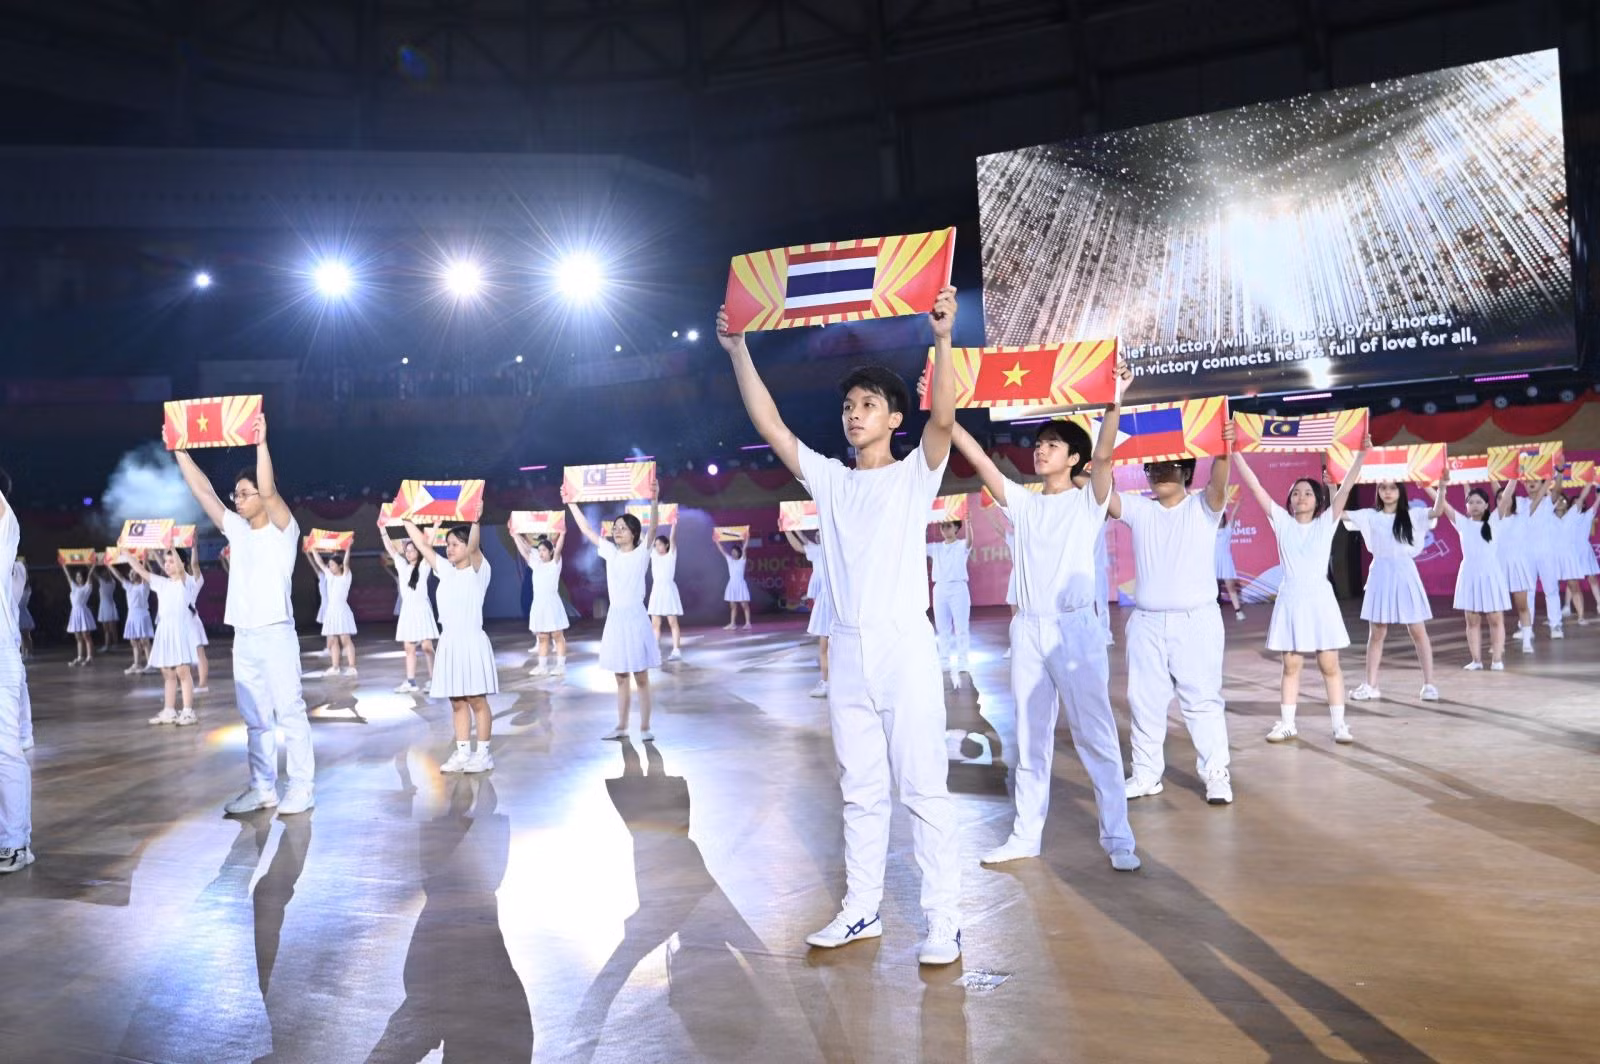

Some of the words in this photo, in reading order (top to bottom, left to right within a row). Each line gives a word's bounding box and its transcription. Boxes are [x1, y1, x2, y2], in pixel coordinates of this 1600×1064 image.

[1131, 363, 1145, 377] in
[1147, 359, 1199, 375] victory
[1202, 349, 1272, 370] connects
[1274, 346, 1326, 362] hearts
[1328, 339, 1357, 356] full
[1359, 336, 1380, 353] of
[1382, 335, 1418, 351] love
[1420, 330, 1448, 347] for
[1451, 326, 1478, 345] all,
[1149, 343, 1163, 357] in
[1166, 339, 1218, 354] victory
[1221, 333, 1248, 348] will
[1252, 330, 1294, 346] bring
[1299, 330, 1317, 341] us
[1319, 323, 1336, 338] to
[1340, 317, 1387, 339] joyful
[1391, 313, 1453, 331] shores,
